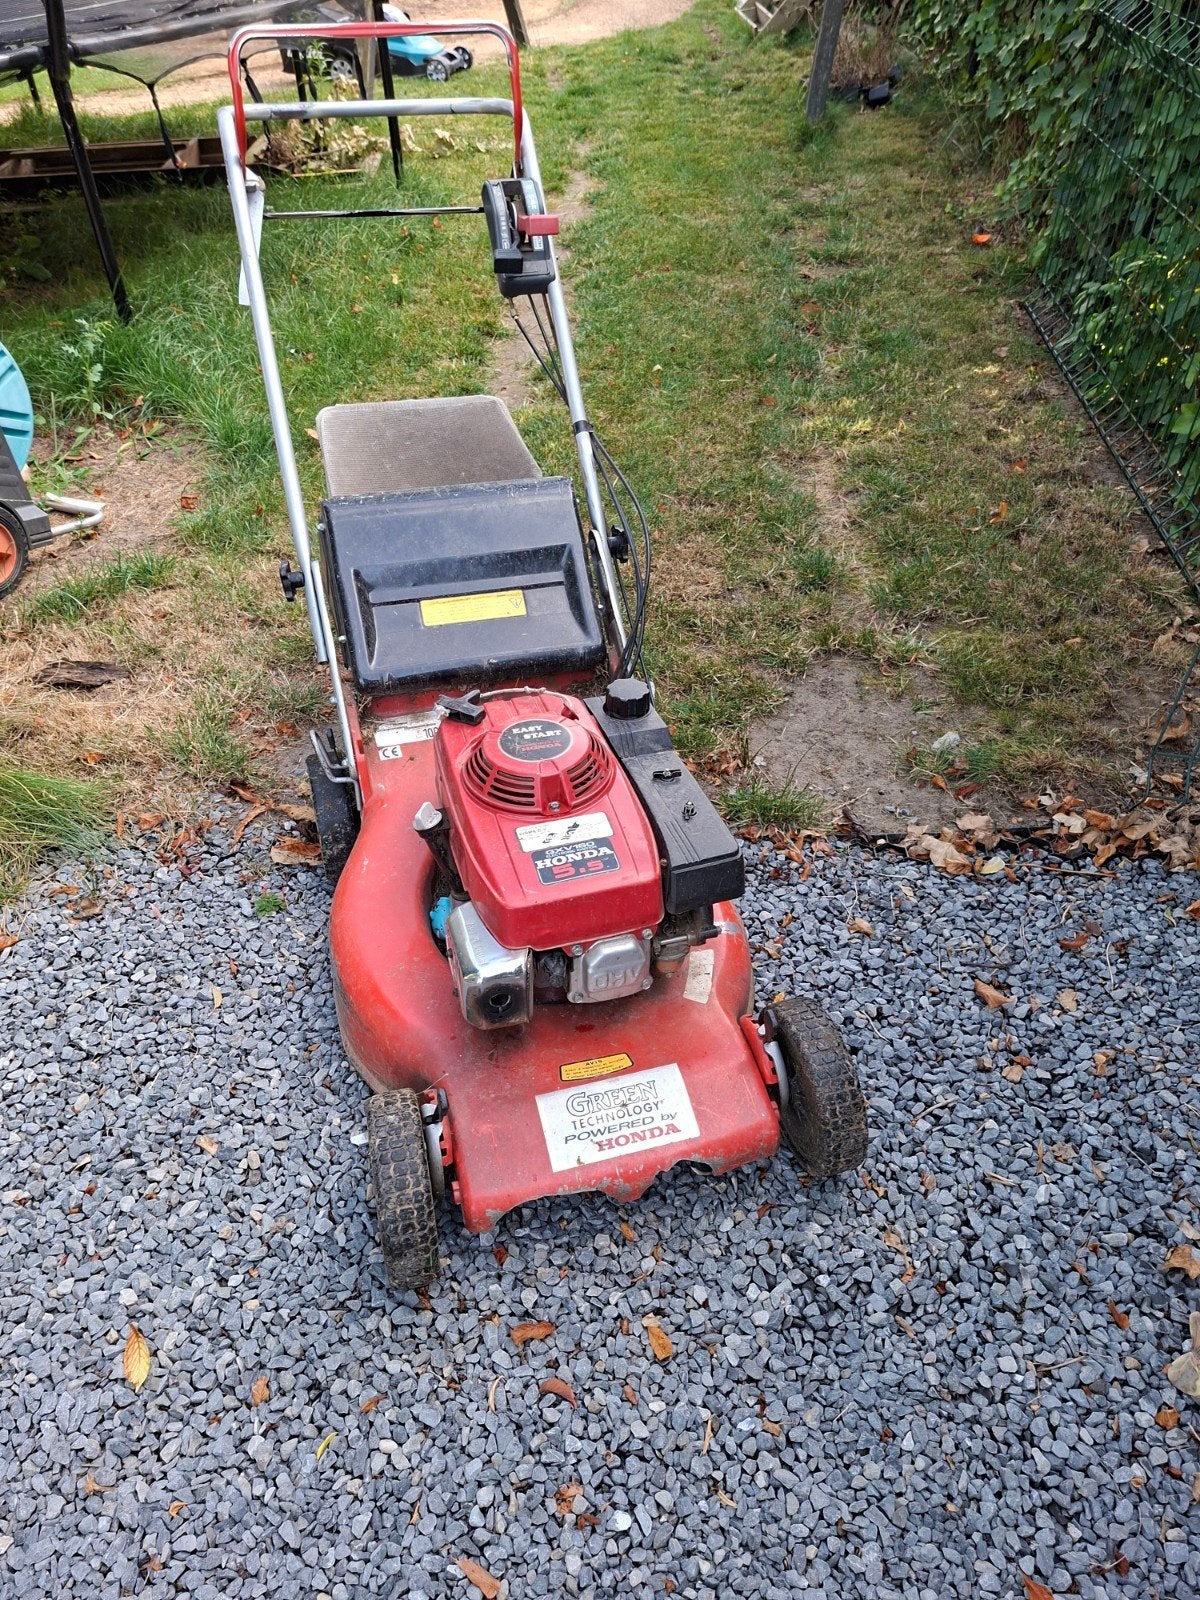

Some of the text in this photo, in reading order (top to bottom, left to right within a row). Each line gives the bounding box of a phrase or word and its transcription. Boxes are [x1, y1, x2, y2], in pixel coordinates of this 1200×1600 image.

[512, 725, 543, 734] EASY
[523, 730, 562, 739] START
[382, 747, 399, 758] CE
[535, 846, 614, 869] HONDA
[552, 860, 604, 879] 5.5
[566, 1080, 659, 1117] GREEN
[571, 1100, 660, 1130] TECHNOLOGY
[564, 1112, 678, 1144] POWERED by
[596, 1123, 681, 1152] HONDA
